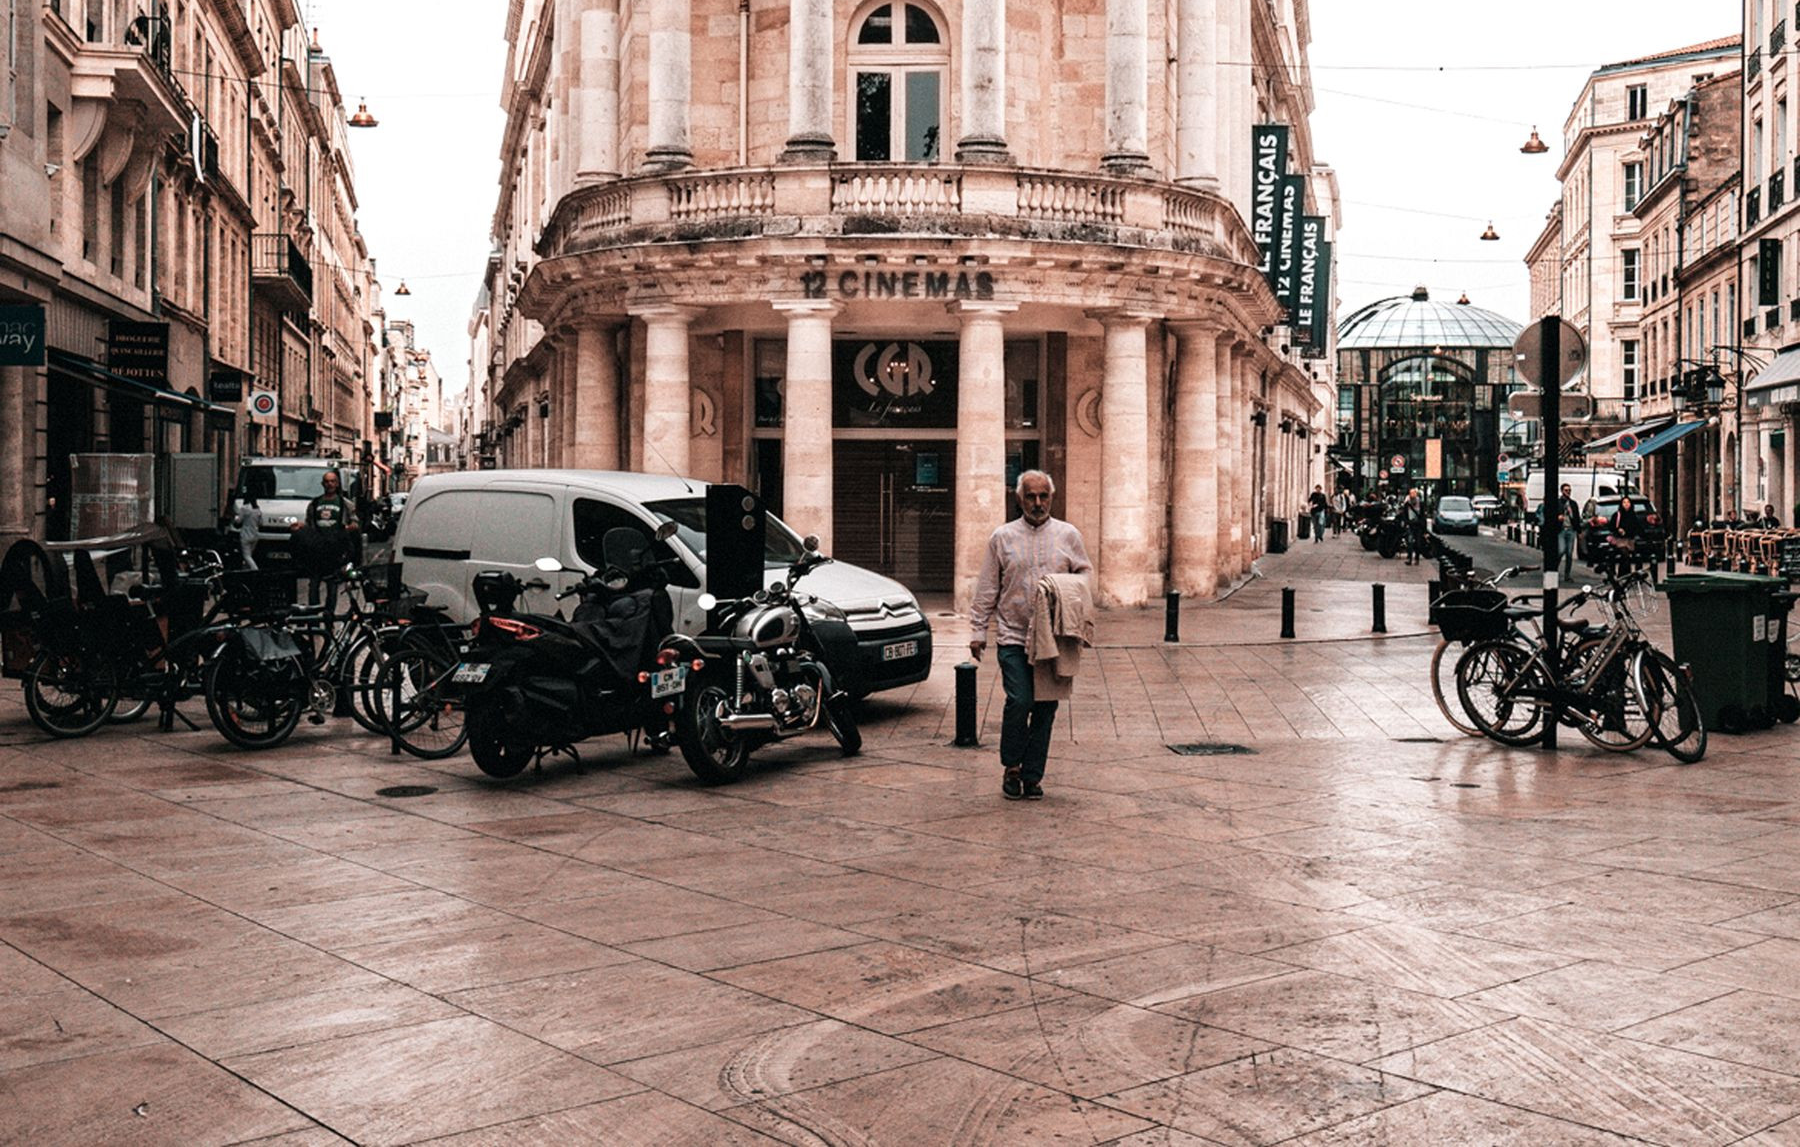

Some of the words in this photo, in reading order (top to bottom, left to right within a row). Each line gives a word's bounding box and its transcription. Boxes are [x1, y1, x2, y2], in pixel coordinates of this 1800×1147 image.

[1255, 134, 1279, 244] FRANÇAIS
[1279, 185, 1295, 271] CINEMAS
[800, 269, 828, 299] 12
[838, 270, 995, 300] CINEMAS
[1277, 277, 1291, 296] 12
[1299, 222, 1319, 304] FRANÇAIS
[1298, 309, 1312, 325] LE
[853, 342, 935, 396] CGR
